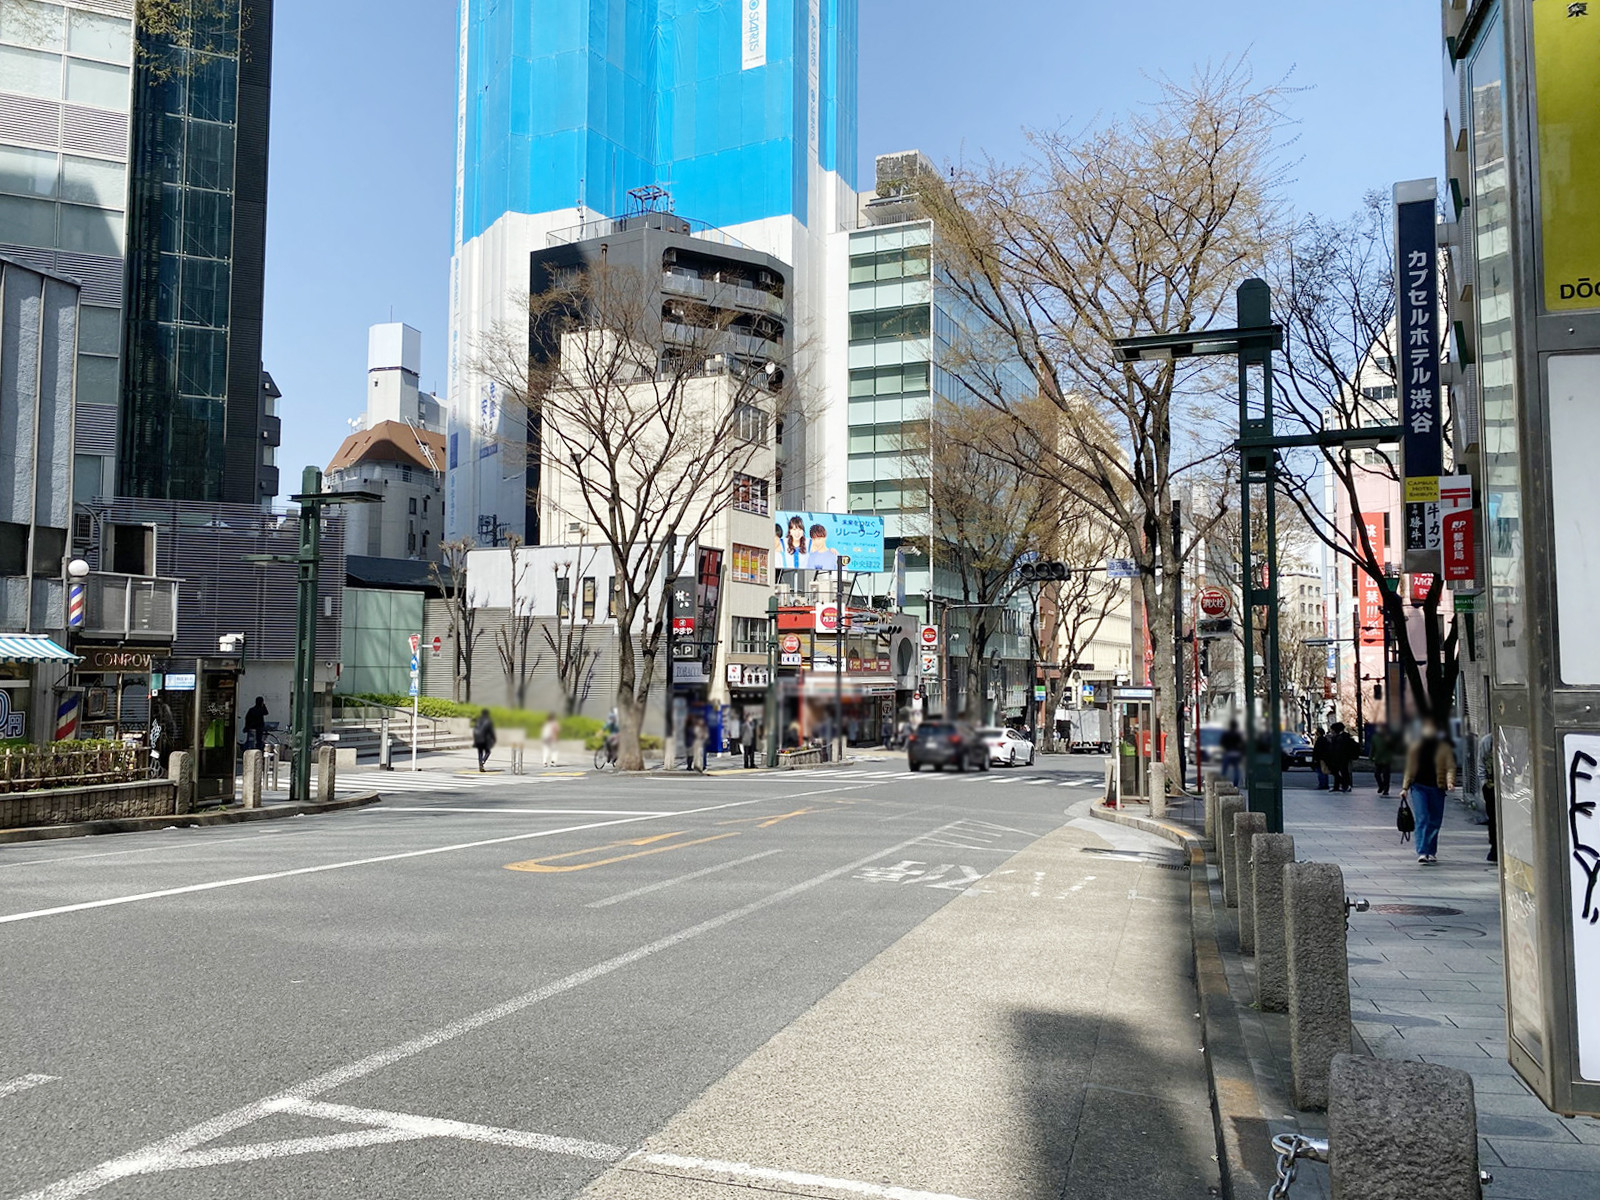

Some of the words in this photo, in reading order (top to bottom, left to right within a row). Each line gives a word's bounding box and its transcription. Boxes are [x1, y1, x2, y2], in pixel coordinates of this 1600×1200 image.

[1408, 250, 1434, 434] カプセルホテル渋谷
[1427, 503, 1441, 548] 牛カツ
[835, 527, 881, 538] リレーワーク
[1453, 532, 1465, 560] 郵便局
[1202, 598, 1225, 609] 消火栓
[672, 627, 694, 635] やまや
[684, 646, 692, 654] P
